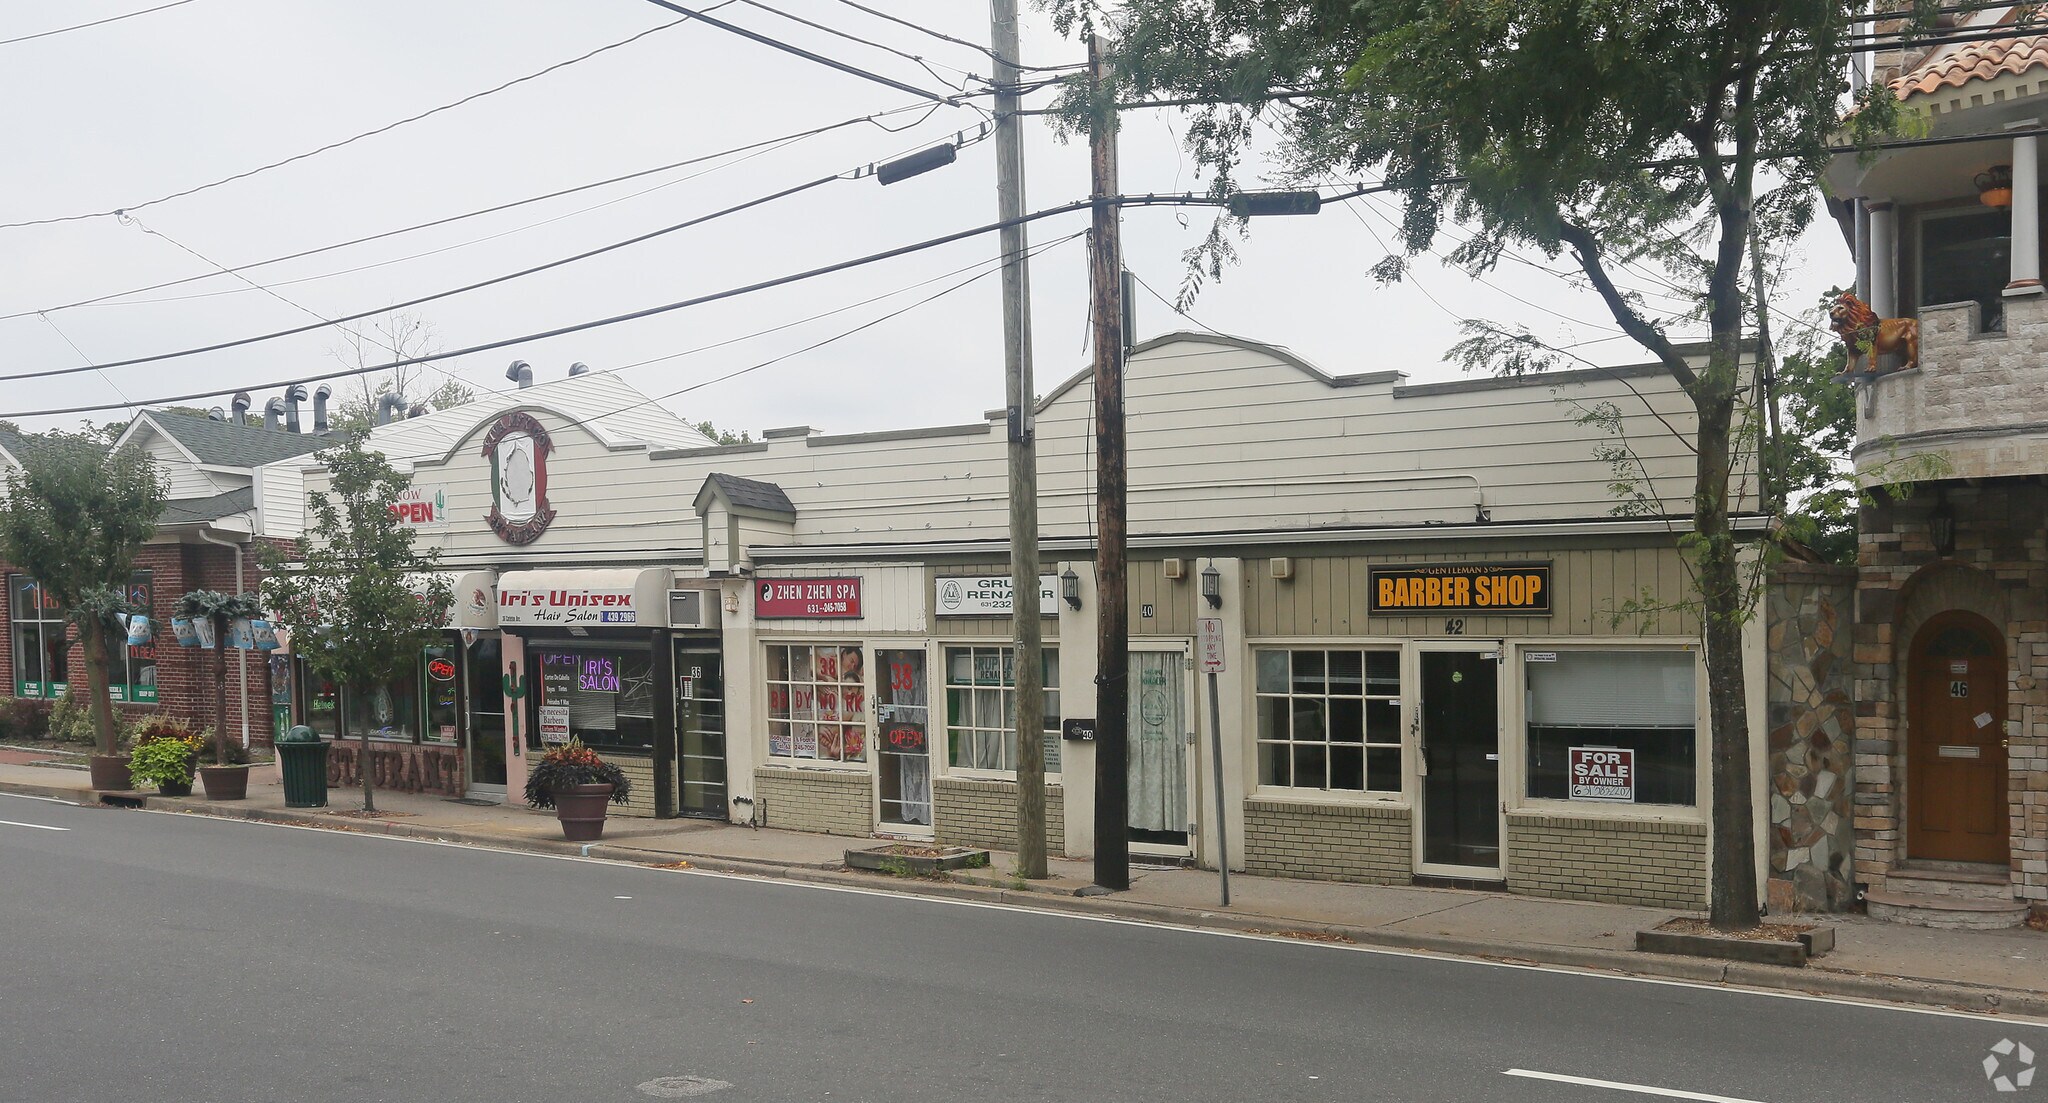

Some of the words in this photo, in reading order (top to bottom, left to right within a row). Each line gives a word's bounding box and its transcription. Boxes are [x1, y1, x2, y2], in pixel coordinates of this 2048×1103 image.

[386, 502, 434, 525] OPEN
[500, 590, 545, 607] Iri's
[549, 590, 632, 607] Unisex
[777, 585, 802, 600] ZHEN
[806, 584, 832, 600] ZHEN
[836, 584, 856, 599] SPA
[966, 589, 1054, 599] RENAR
[1378, 576, 1470, 607] BARBER
[1475, 575, 1542, 606] SHOP
[534, 608, 561, 621] Hair
[564, 608, 598, 623] Salon
[1142, 605, 1153, 617] 40
[1205, 622, 1215, 633] NO
[1445, 617, 1464, 635] 42
[1206, 652, 1217, 660] TIME
[430, 661, 453, 676] OPEN
[584, 657, 613, 676] IRI'S
[692, 667, 701, 678] 36
[820, 657, 837, 676] 38
[579, 675, 619, 691] SALON
[891, 663, 913, 691] 38
[1951, 681, 1968, 697] 46
[543, 715, 565, 724] Barbero
[1082, 730, 1093, 740] 40
[1581, 752, 1621, 765] FOR
[1574, 763, 1629, 778] SALE
[1579, 776, 1591, 784] BY
[1593, 777, 1624, 786] OWNER
